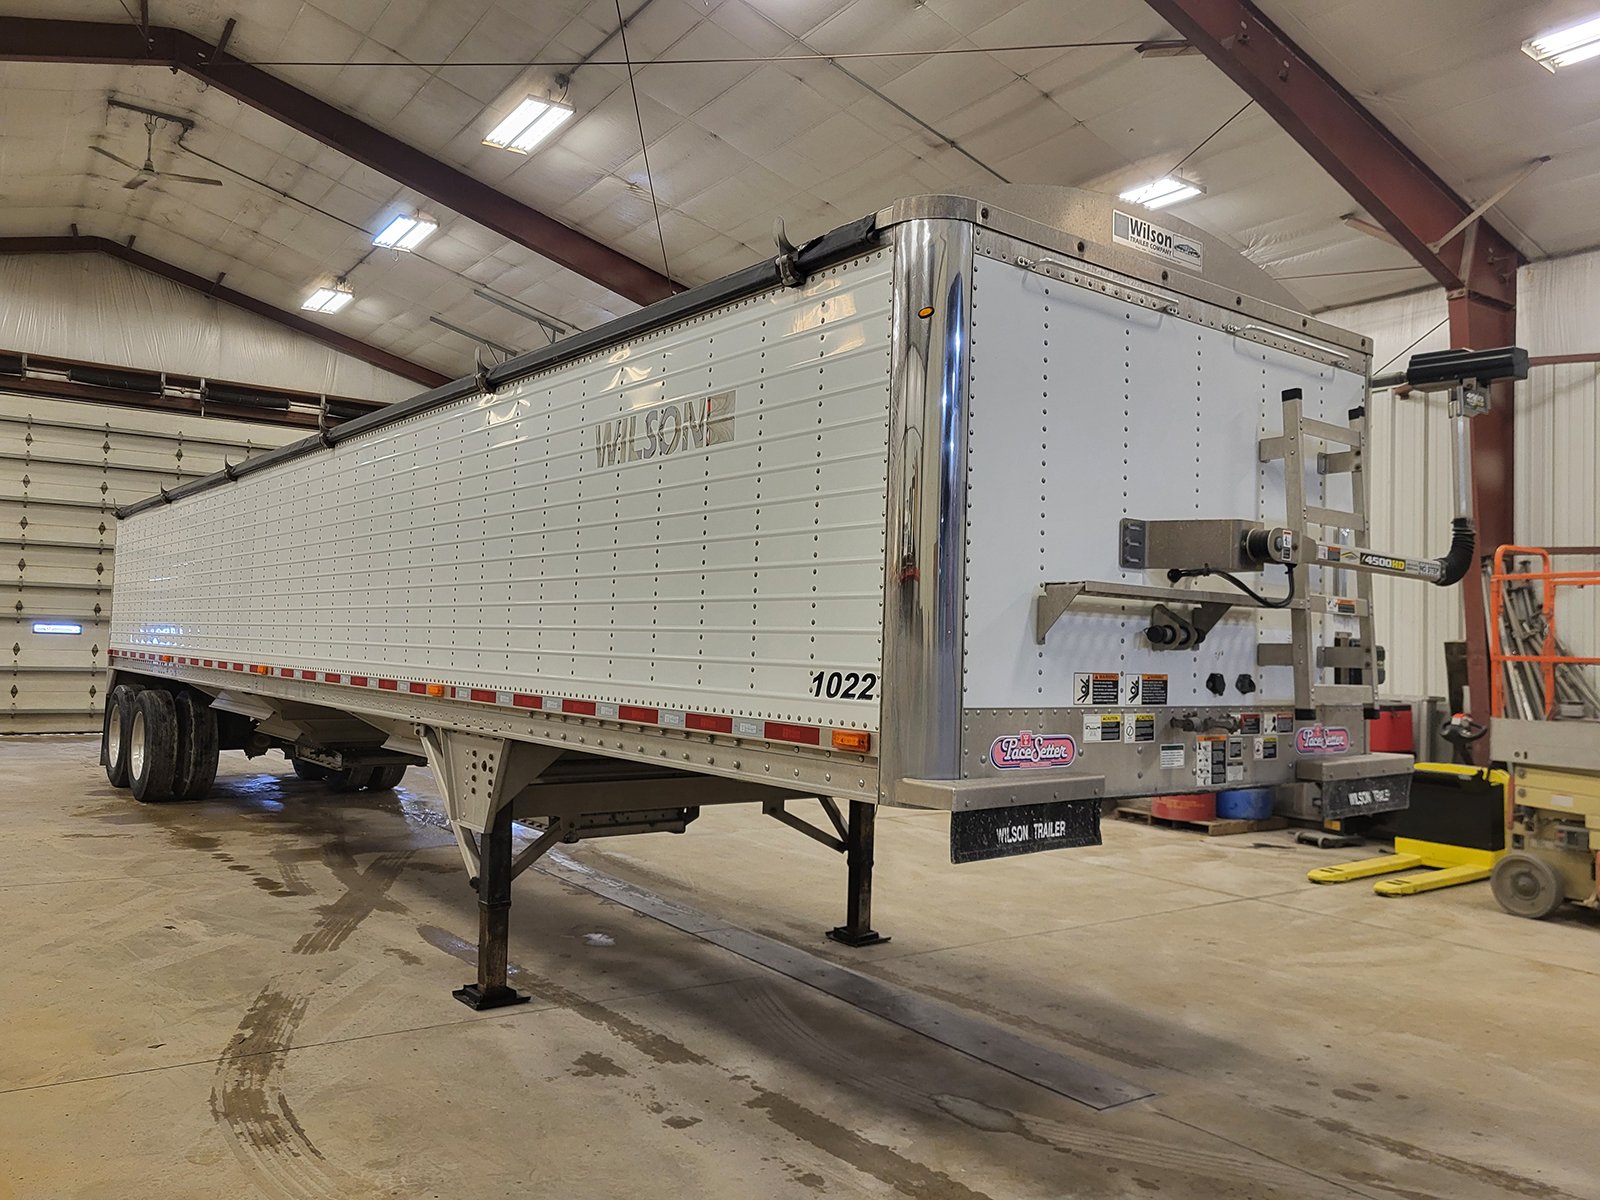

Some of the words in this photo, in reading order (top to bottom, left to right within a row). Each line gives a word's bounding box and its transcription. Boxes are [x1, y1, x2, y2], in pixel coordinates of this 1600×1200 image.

[1129, 217, 1173, 249] Wilson
[1130, 235, 1149, 247] TRAILER
[1149, 243, 1172, 257] COMPANY
[595, 397, 706, 468] WILSON
[1364, 555, 1405, 570] 4500HD
[812, 671, 877, 701] 1022
[996, 825, 1029, 843] WILSON
[1033, 820, 1067, 839] TRAILER
